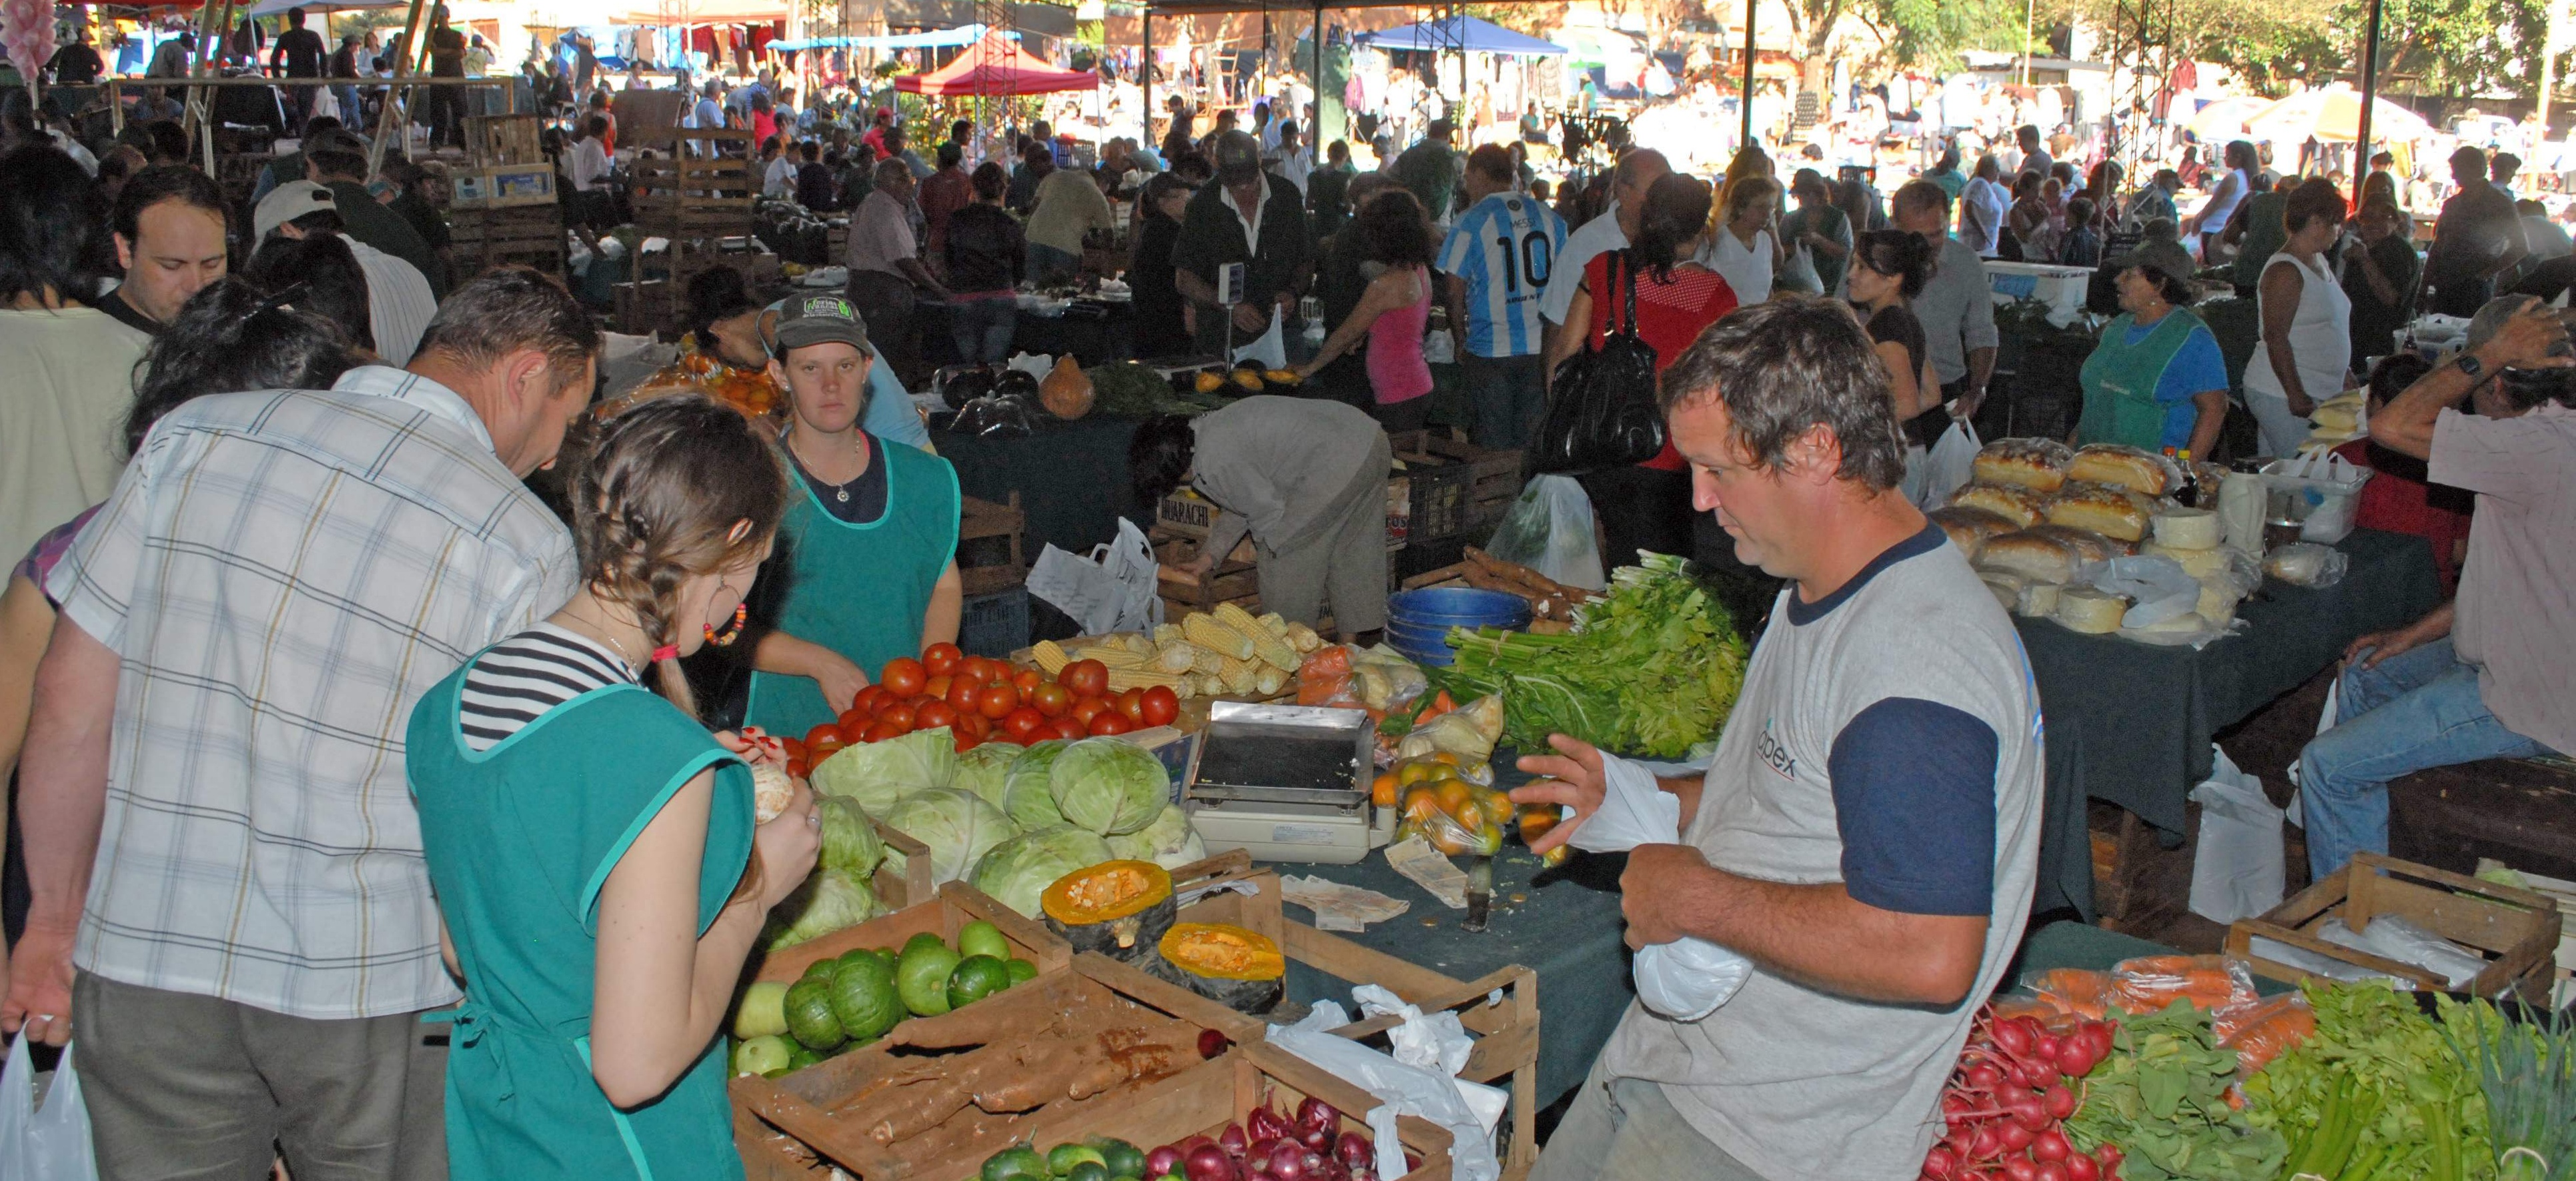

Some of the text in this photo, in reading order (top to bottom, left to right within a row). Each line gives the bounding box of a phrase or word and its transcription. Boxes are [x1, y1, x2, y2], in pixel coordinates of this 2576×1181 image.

[1497, 231, 1551, 292] 10
[1162, 499, 1209, 527] HUARACHI
[1758, 730, 1796, 778] apex
